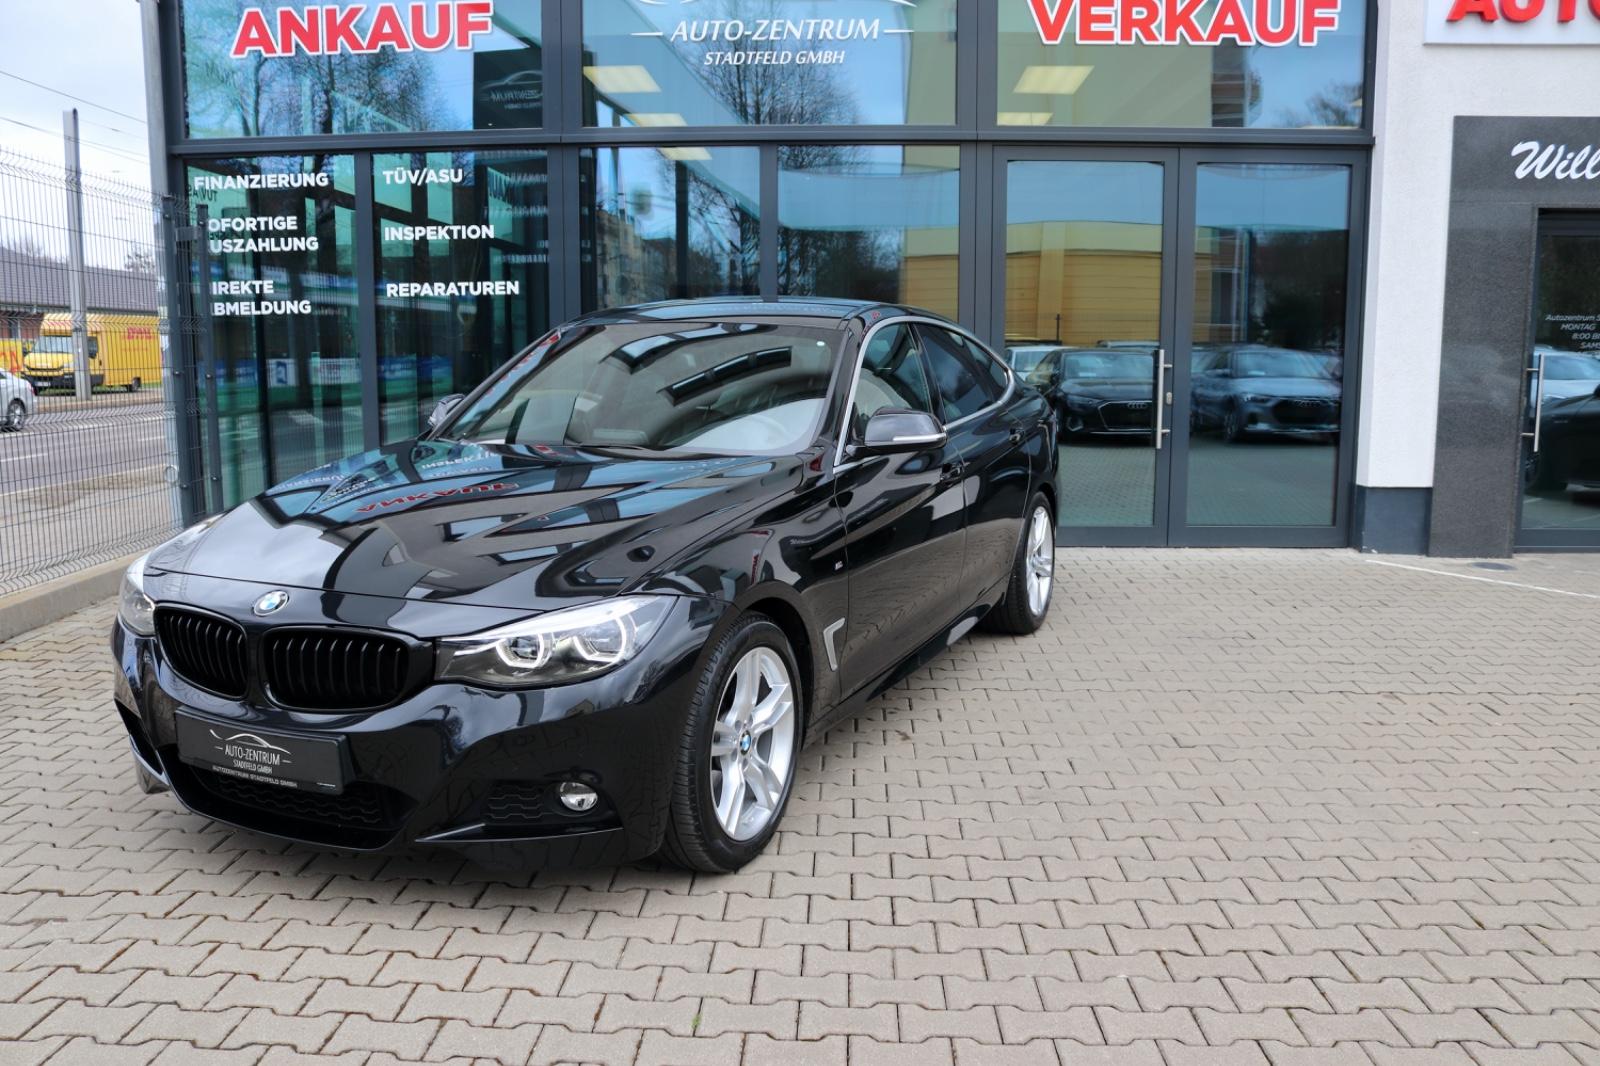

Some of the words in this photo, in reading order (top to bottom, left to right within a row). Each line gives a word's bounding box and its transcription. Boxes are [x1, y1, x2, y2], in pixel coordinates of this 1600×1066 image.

[1446, 0, 1600, 23] AUT
[231, 1, 494, 57] ANKAUF
[671, 18, 880, 43] AUTO-ZENTRUM
[1027, 0, 1342, 46] VERKAUF
[704, 51, 791, 66] STADTFELD
[795, 50, 845, 65] GMBH
[194, 172, 330, 190] FINANZIERUNG
[382, 167, 464, 186] TÜV/ASU
[208, 215, 299, 232] OFORTIGE
[384, 224, 495, 241] INSPEKTION
[209, 236, 320, 253] USZAHLUNG
[211, 279, 275, 295] IREKTE
[386, 280, 520, 298] REPARATUREN
[211, 300, 313, 316] BMELDUNG
[224, 744, 281, 766] AUTO-ZENTRUM
